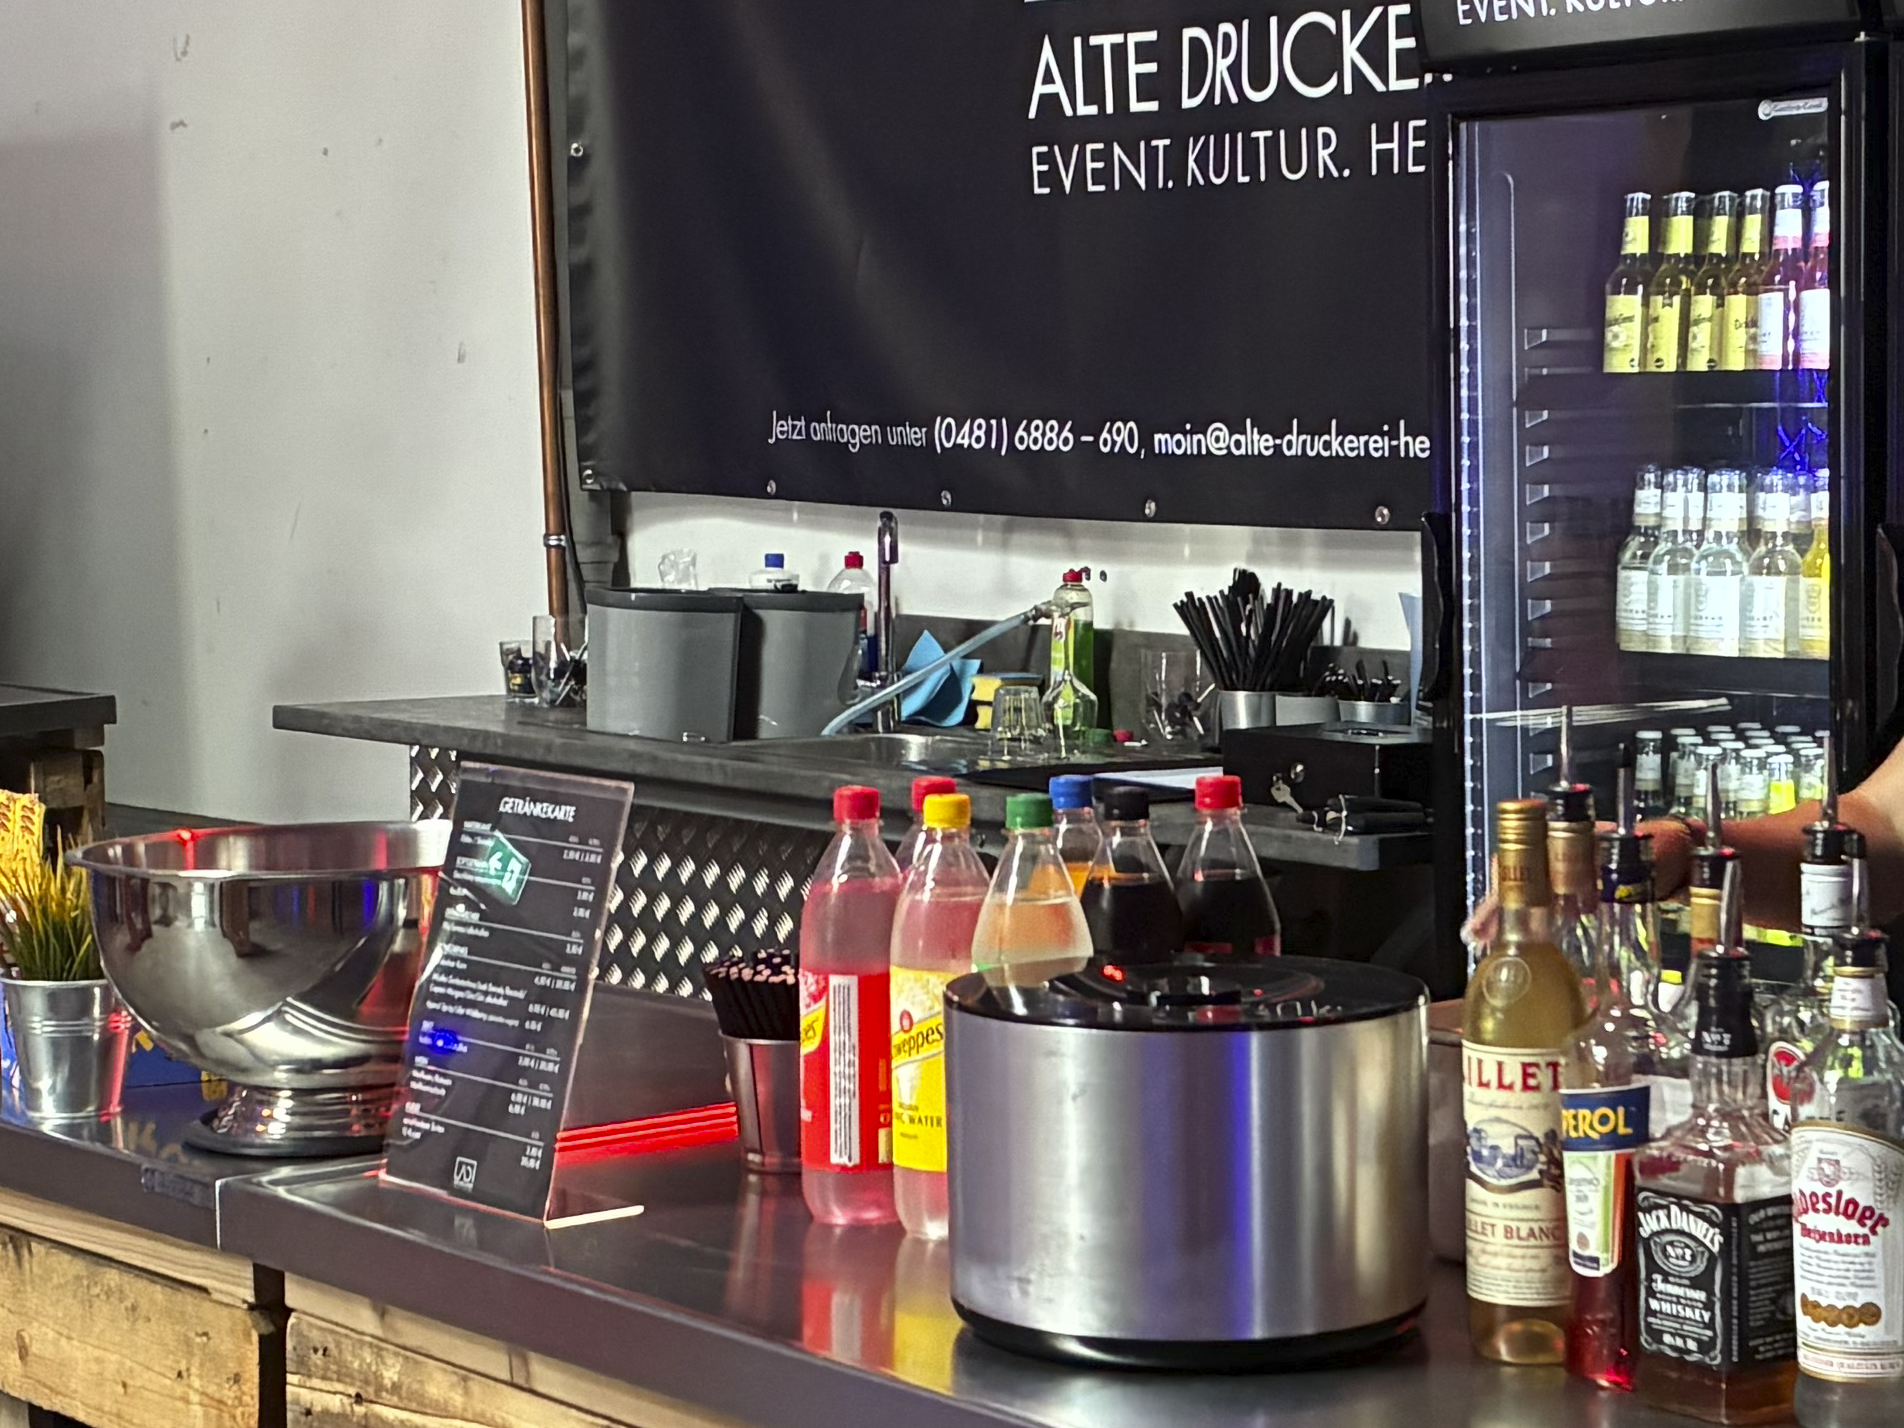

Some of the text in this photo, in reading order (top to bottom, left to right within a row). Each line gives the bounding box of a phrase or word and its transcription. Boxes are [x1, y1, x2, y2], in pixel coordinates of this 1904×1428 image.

[1028, 3, 1453, 120] ALTE DRUCKE
[1030, 138, 1174, 195] EVENT.
[1187, 126, 1351, 188] KULTUR.
[768, 410, 807, 445] Jetzt
[810, 410, 882, 453] anfragen
[886, 421, 928, 448] unter
[934, 416, 1008, 456] (0481)
[1014, 419, 1075, 452] 6886
[1098, 420, 1146, 460] 690,
[1153, 418, 1431, 458] moin@alte-druckerei-he
[498, 797, 576, 822] GETRÄNKEKARTE
[1647, 1297, 1712, 1324] WHISKEY
